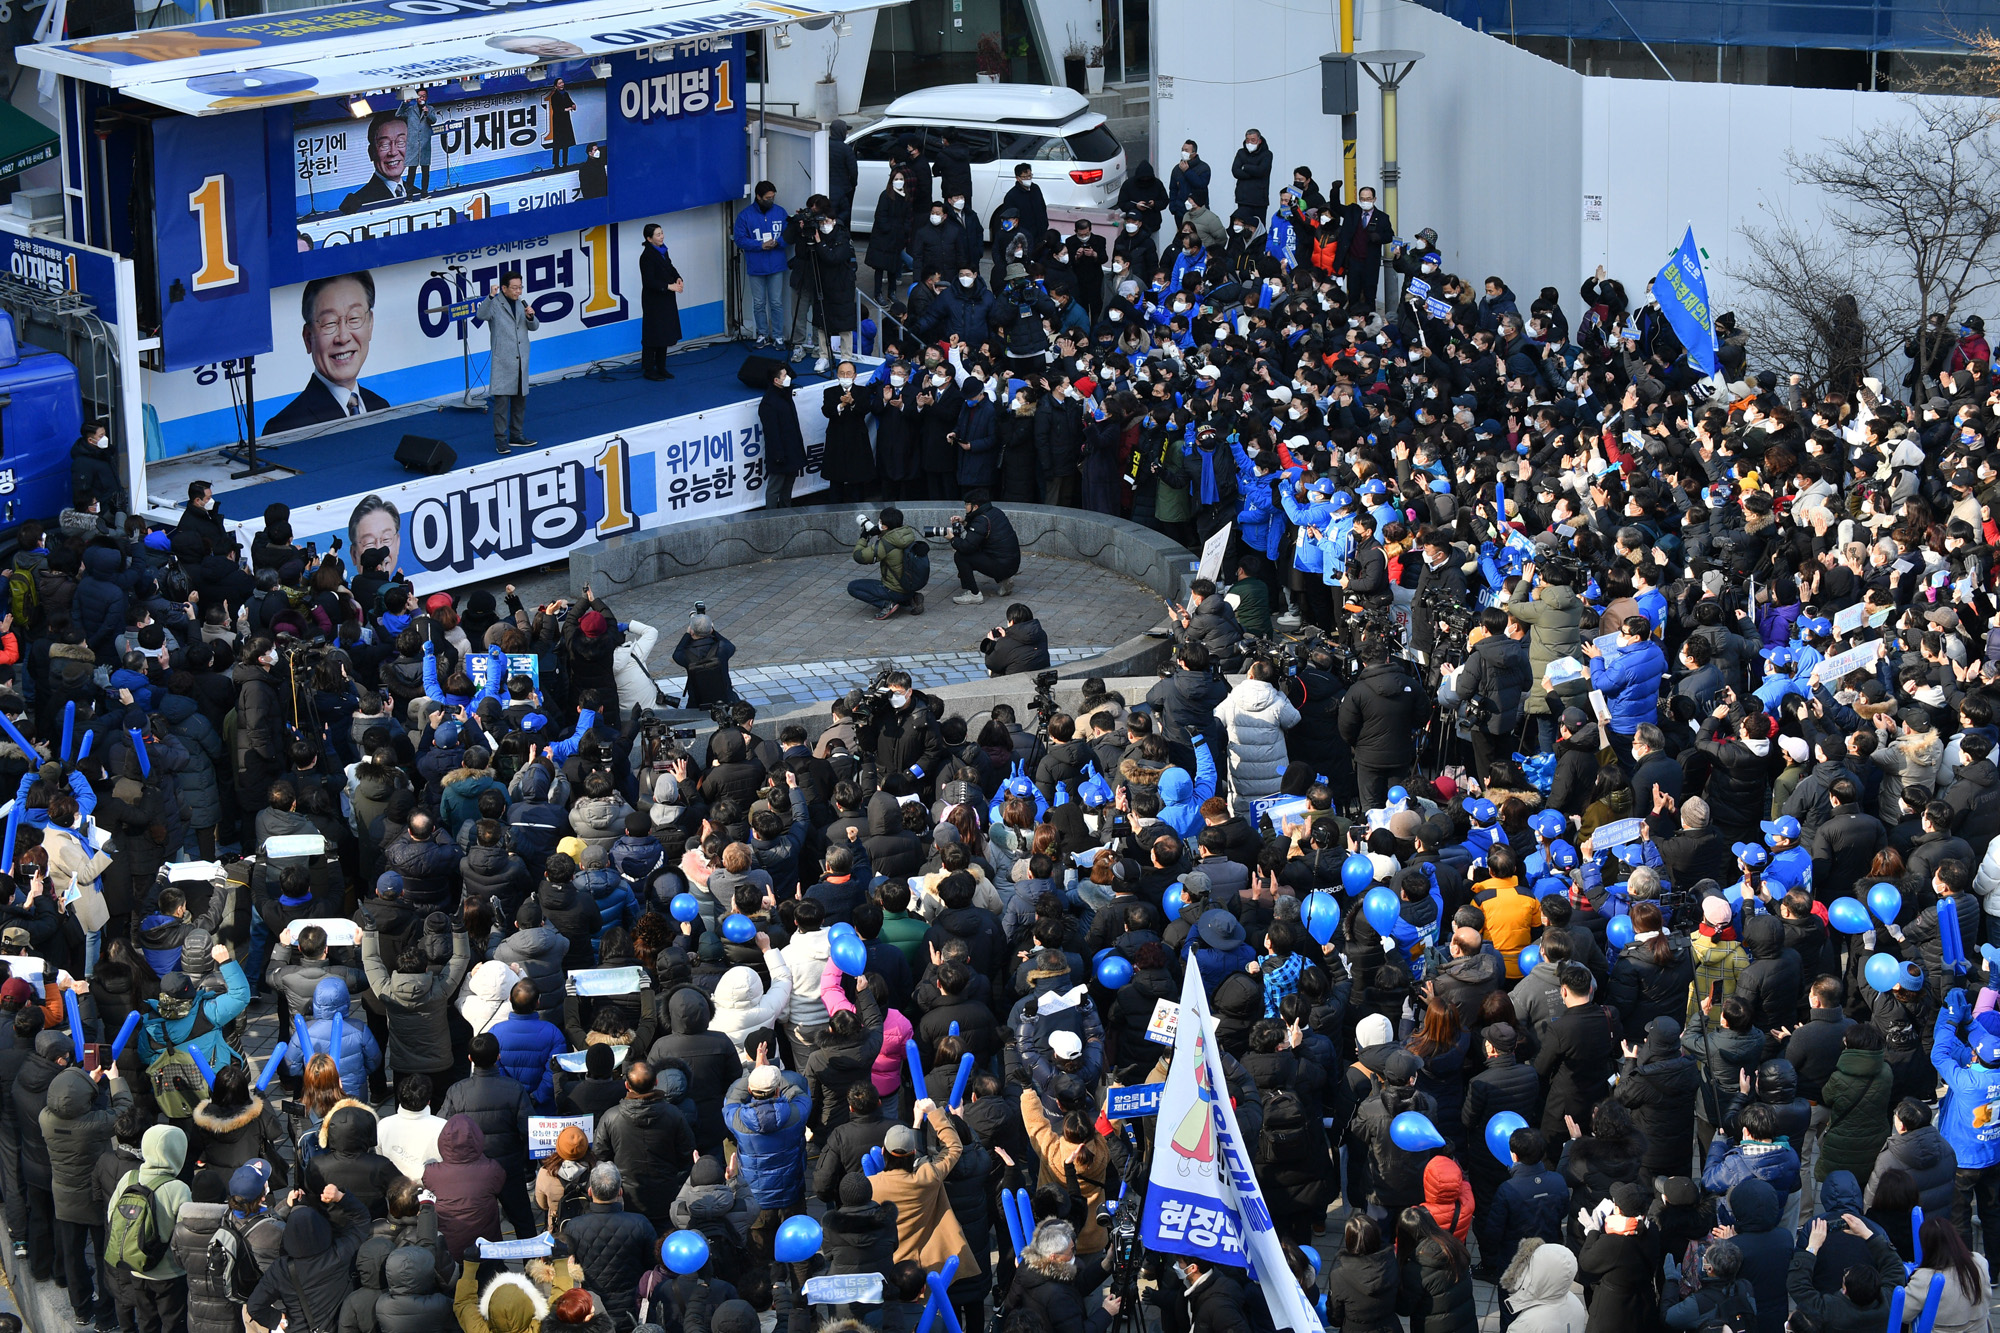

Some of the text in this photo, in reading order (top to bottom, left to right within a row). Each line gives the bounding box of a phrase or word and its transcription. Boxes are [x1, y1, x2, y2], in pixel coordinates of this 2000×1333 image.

[226, 17, 314, 34] 위기에
[265, 15, 405, 37] 경제대통령
[590, 10, 780, 45] 이재명
[358, 60, 426, 76] 위기에
[620, 60, 734, 120] 이재명 1
[440, 104, 538, 155] 이재명
[297, 132, 347, 156] 위기에
[298, 155, 339, 179] 강한!
[189, 174, 240, 292] 1
[1272, 227, 1279, 240] 1
[14, 238, 62, 261] 유능한 경제대통령
[11, 252, 82, 300] 이재명 1
[417, 223, 629, 340] 이재명 1
[667, 423, 763, 474] 위기에 강
[668, 465, 736, 511] 유능한
[409, 438, 638, 569] 이재명 1
[1320, 885, 1344, 894] DESCEN
[1114, 1093, 1139, 1103] 앞으로
[1114, 1102, 1139, 1112] 제대로
